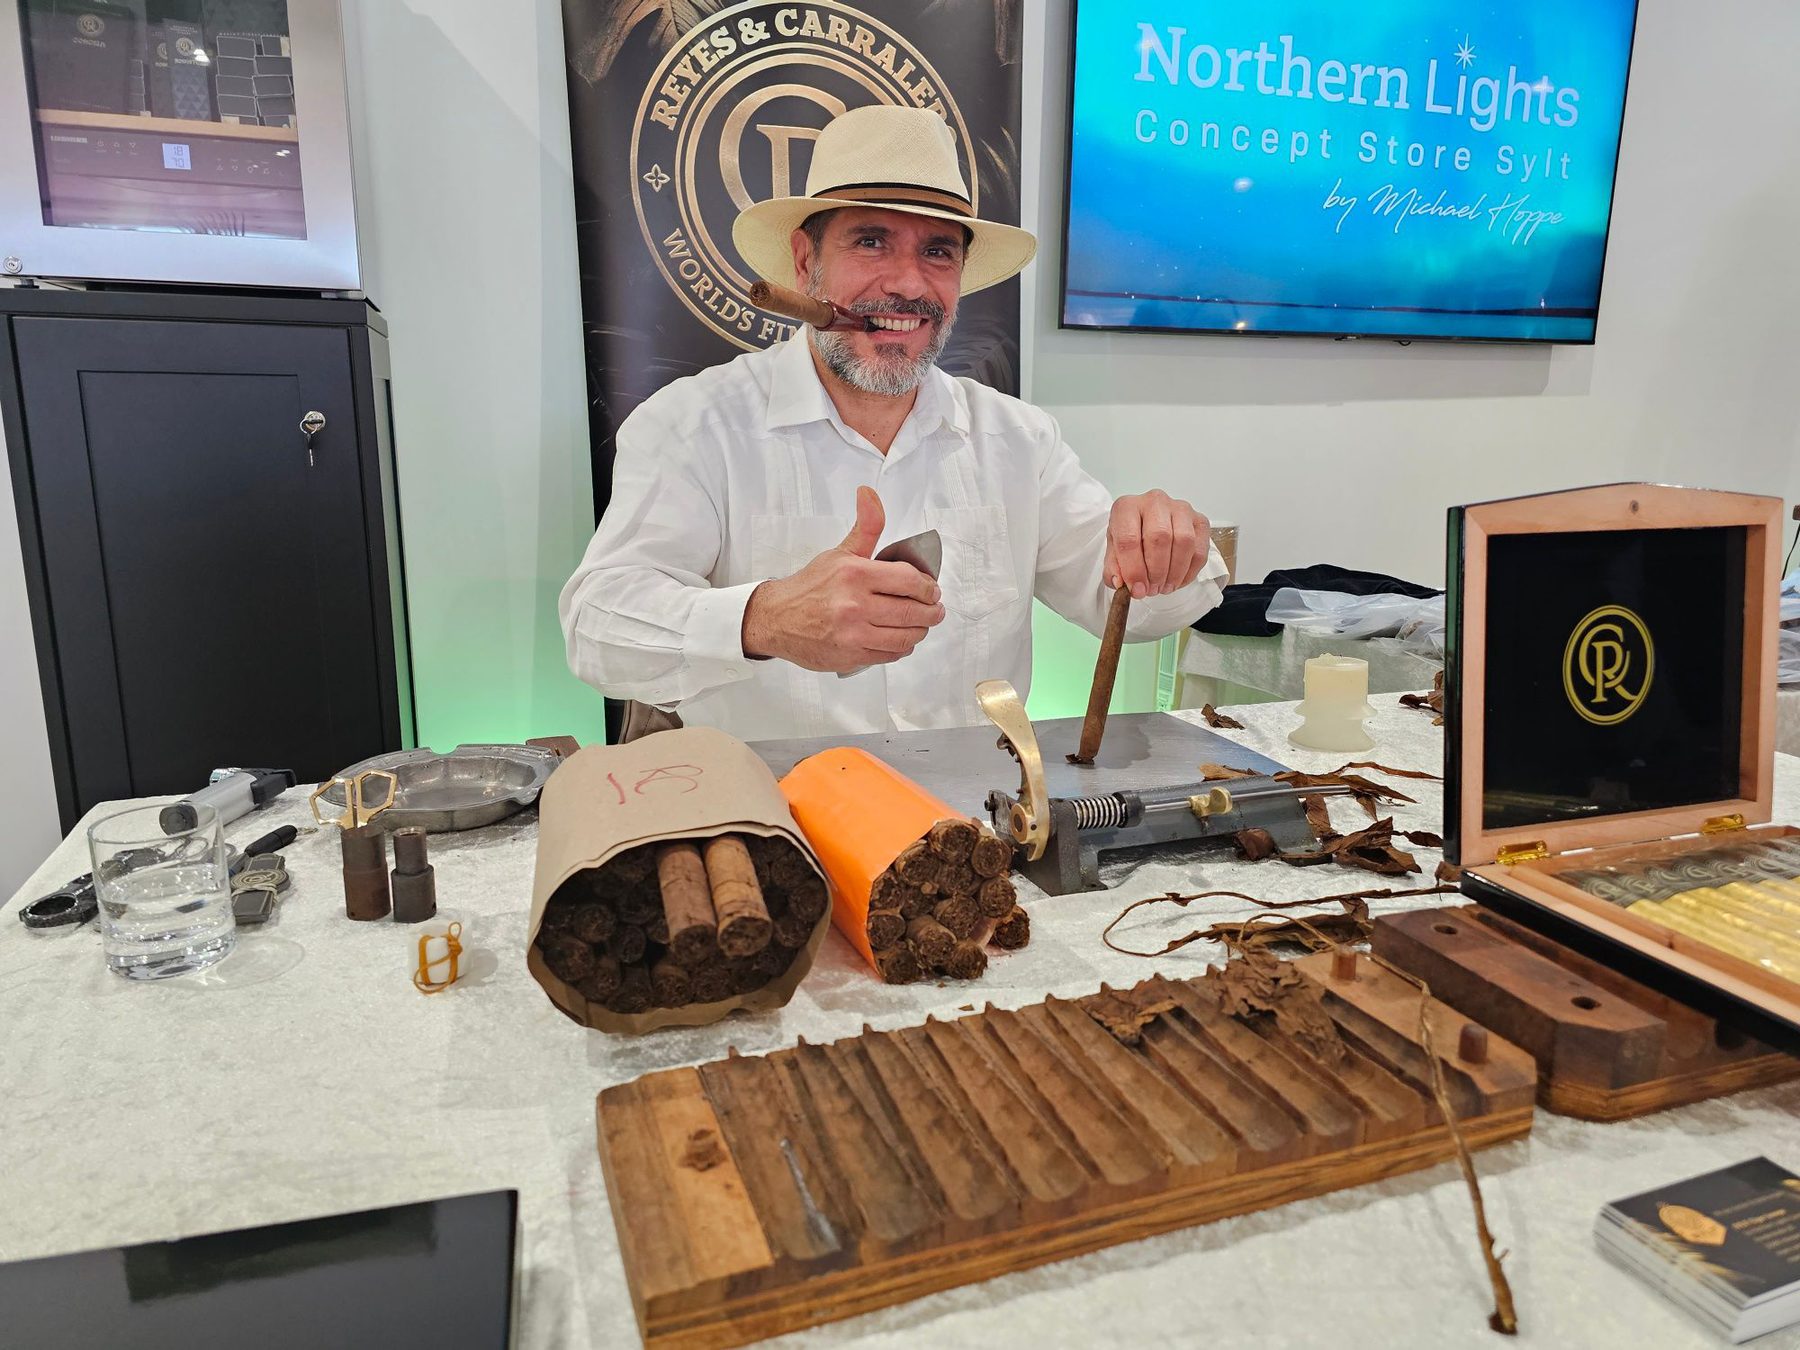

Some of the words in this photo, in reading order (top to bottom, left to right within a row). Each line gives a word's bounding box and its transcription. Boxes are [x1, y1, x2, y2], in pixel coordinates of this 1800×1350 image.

[650, 25, 737, 131] REYES
[738, 17, 771, 46] &
[774, 8, 957, 143] CARRALE
[1133, 22, 1410, 110] Northern
[1426, 34, 1580, 132] Lights
[1134, 109, 1332, 163] Concept
[1358, 130, 1472, 172] Store
[1496, 146, 1571, 183] Sylt
[1322, 178, 1358, 234] by
[1367, 183, 1487, 234] Michael
[1488, 193, 1566, 246] Hoppe
[663, 228, 756, 332] WORLD'S
